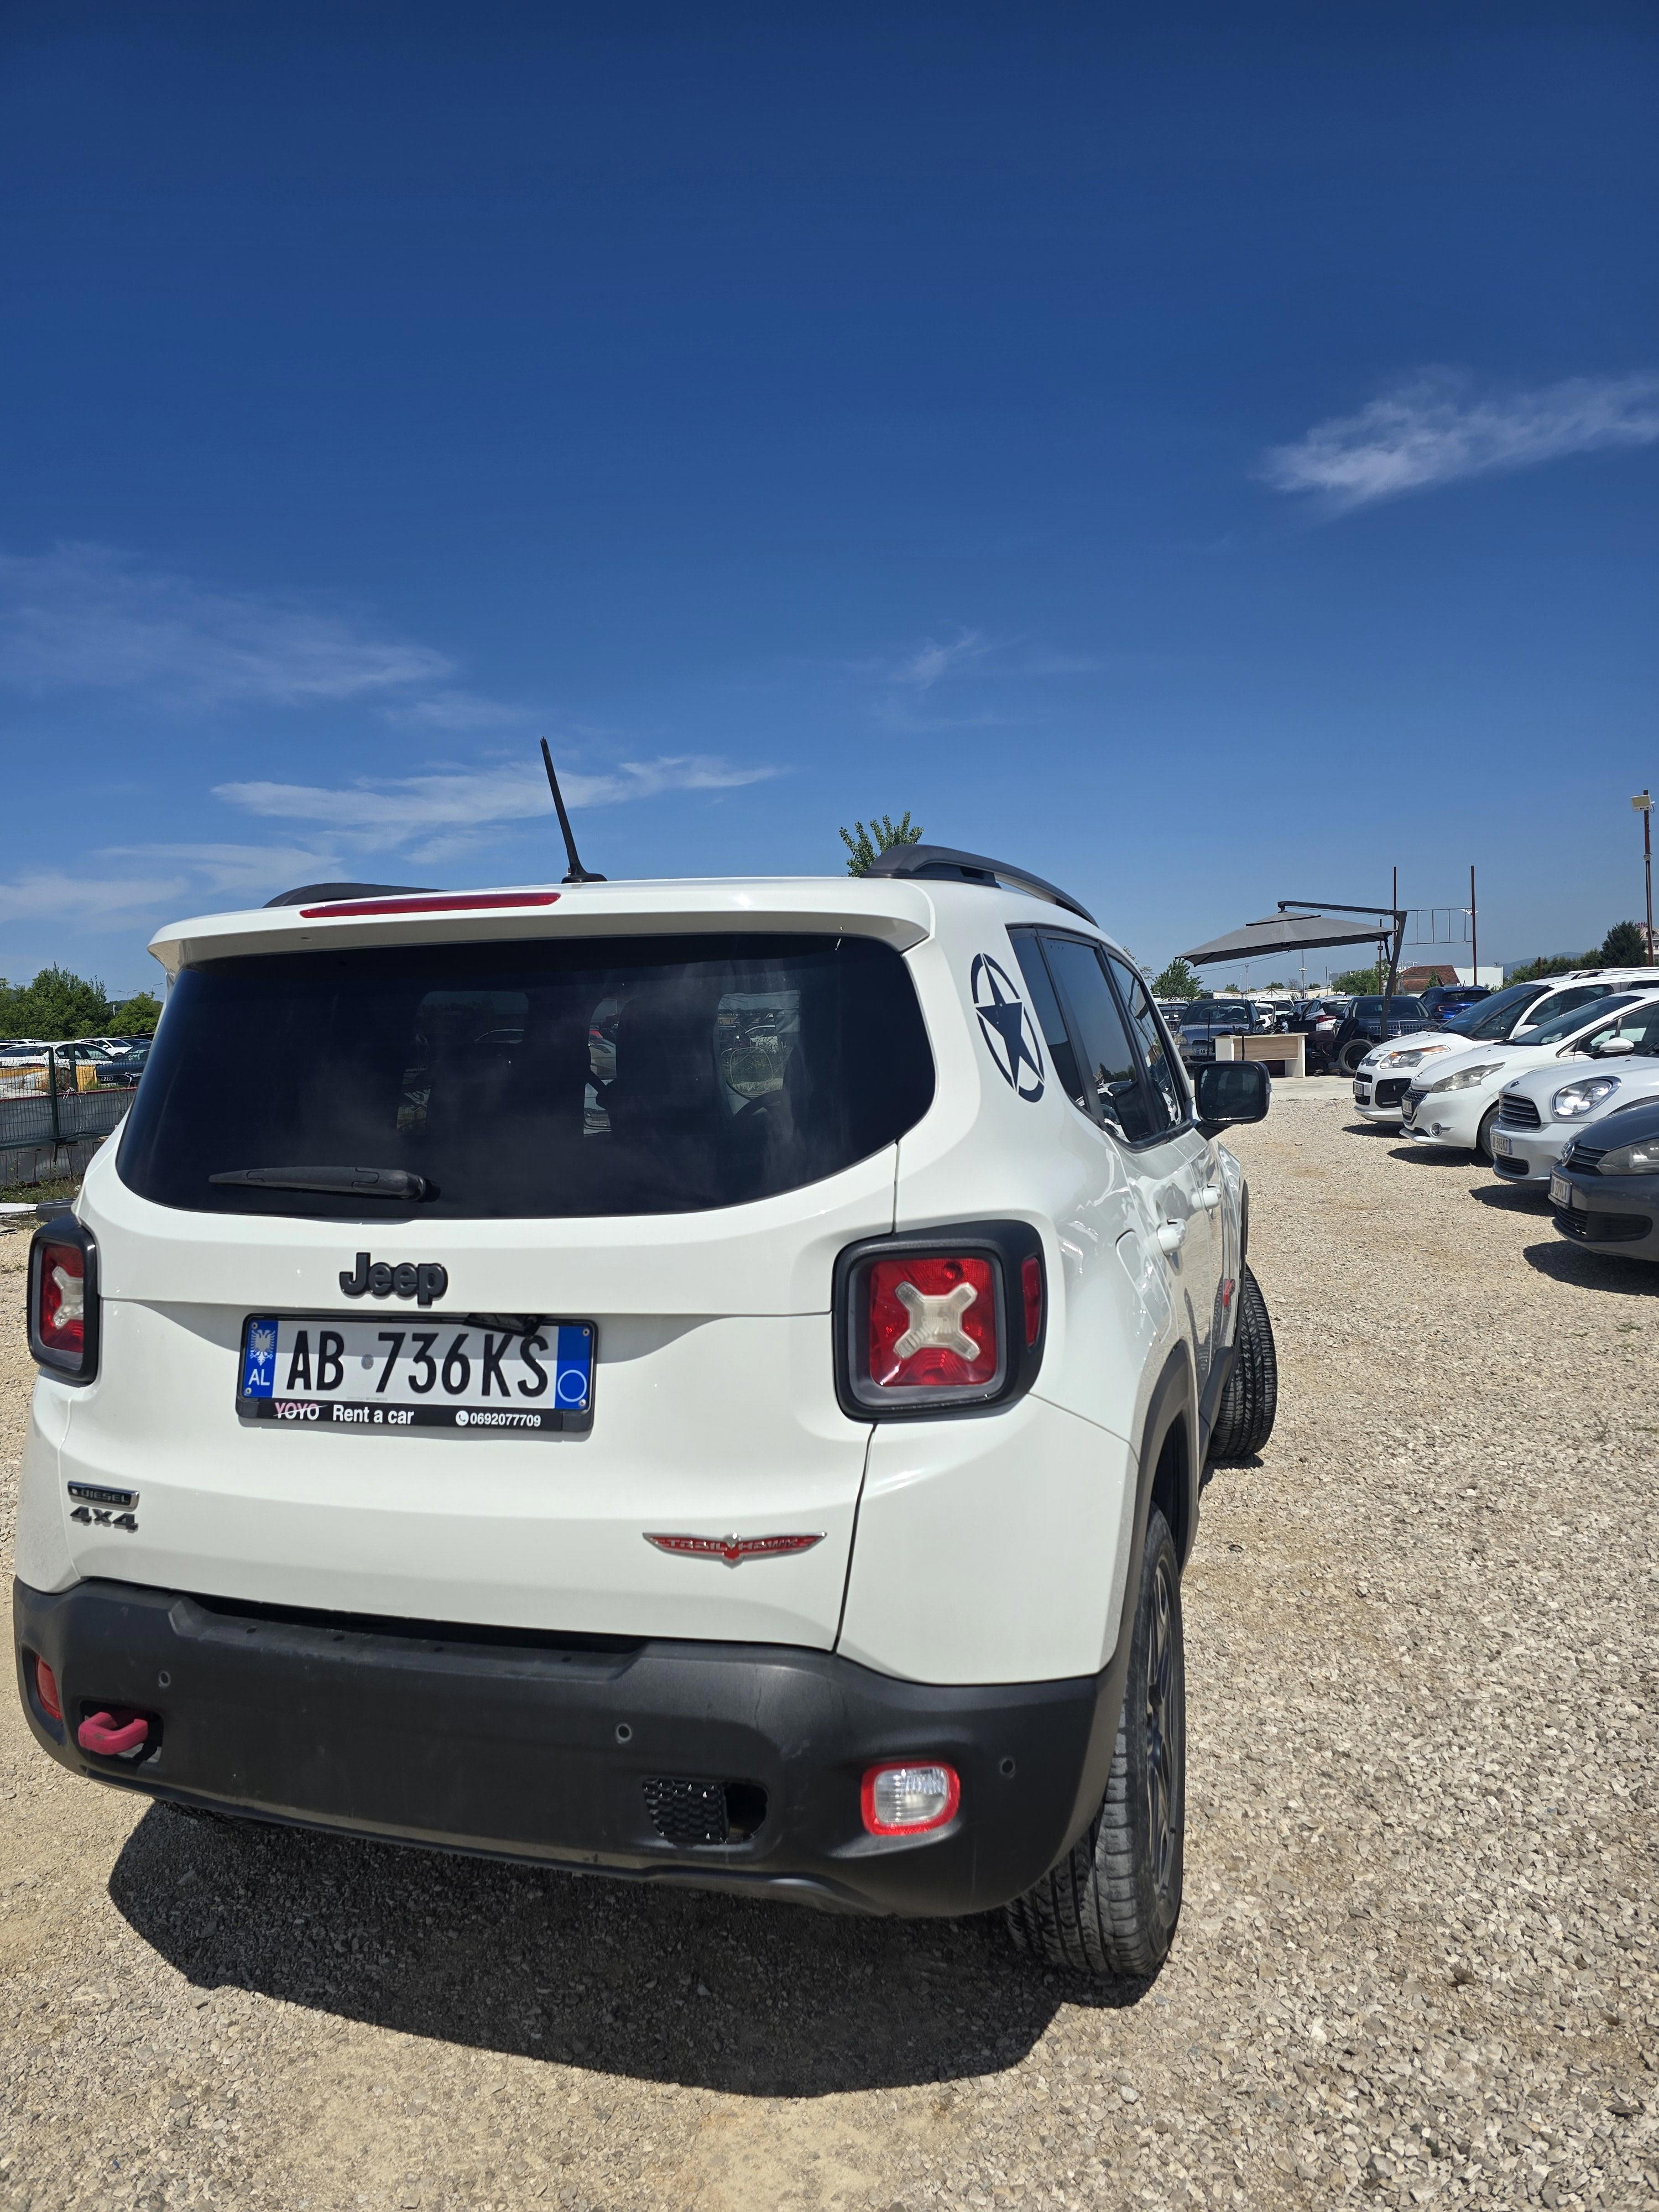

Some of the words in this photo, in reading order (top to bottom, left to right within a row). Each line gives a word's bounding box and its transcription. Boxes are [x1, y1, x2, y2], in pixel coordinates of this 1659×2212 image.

[339, 1252, 448, 1305] Jeep
[286, 1331, 345, 1391] AB
[248, 1369, 270, 1386] AL
[274, 1402, 320, 1420] YOYO
[333, 1404, 370, 1422] Rent
[373, 1410, 383, 1423] a
[388, 1410, 415, 1425] car
[469, 1412, 541, 1427] 0692077709
[81, 1489, 130, 1503] DIESEL
